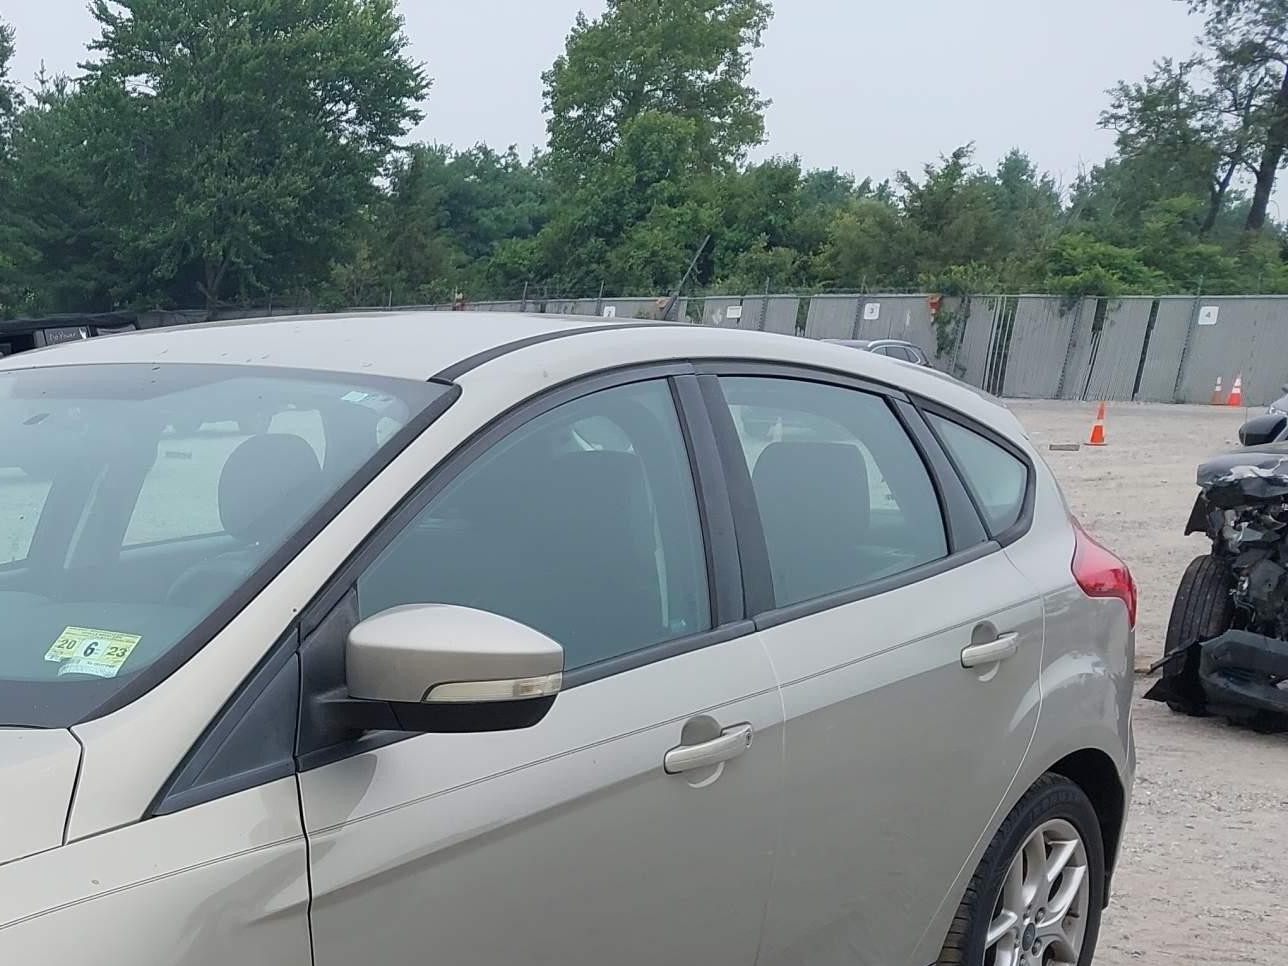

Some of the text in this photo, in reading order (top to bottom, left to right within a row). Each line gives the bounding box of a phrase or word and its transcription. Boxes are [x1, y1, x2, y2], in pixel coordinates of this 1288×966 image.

[56, 639, 128, 658] 20 6 23
